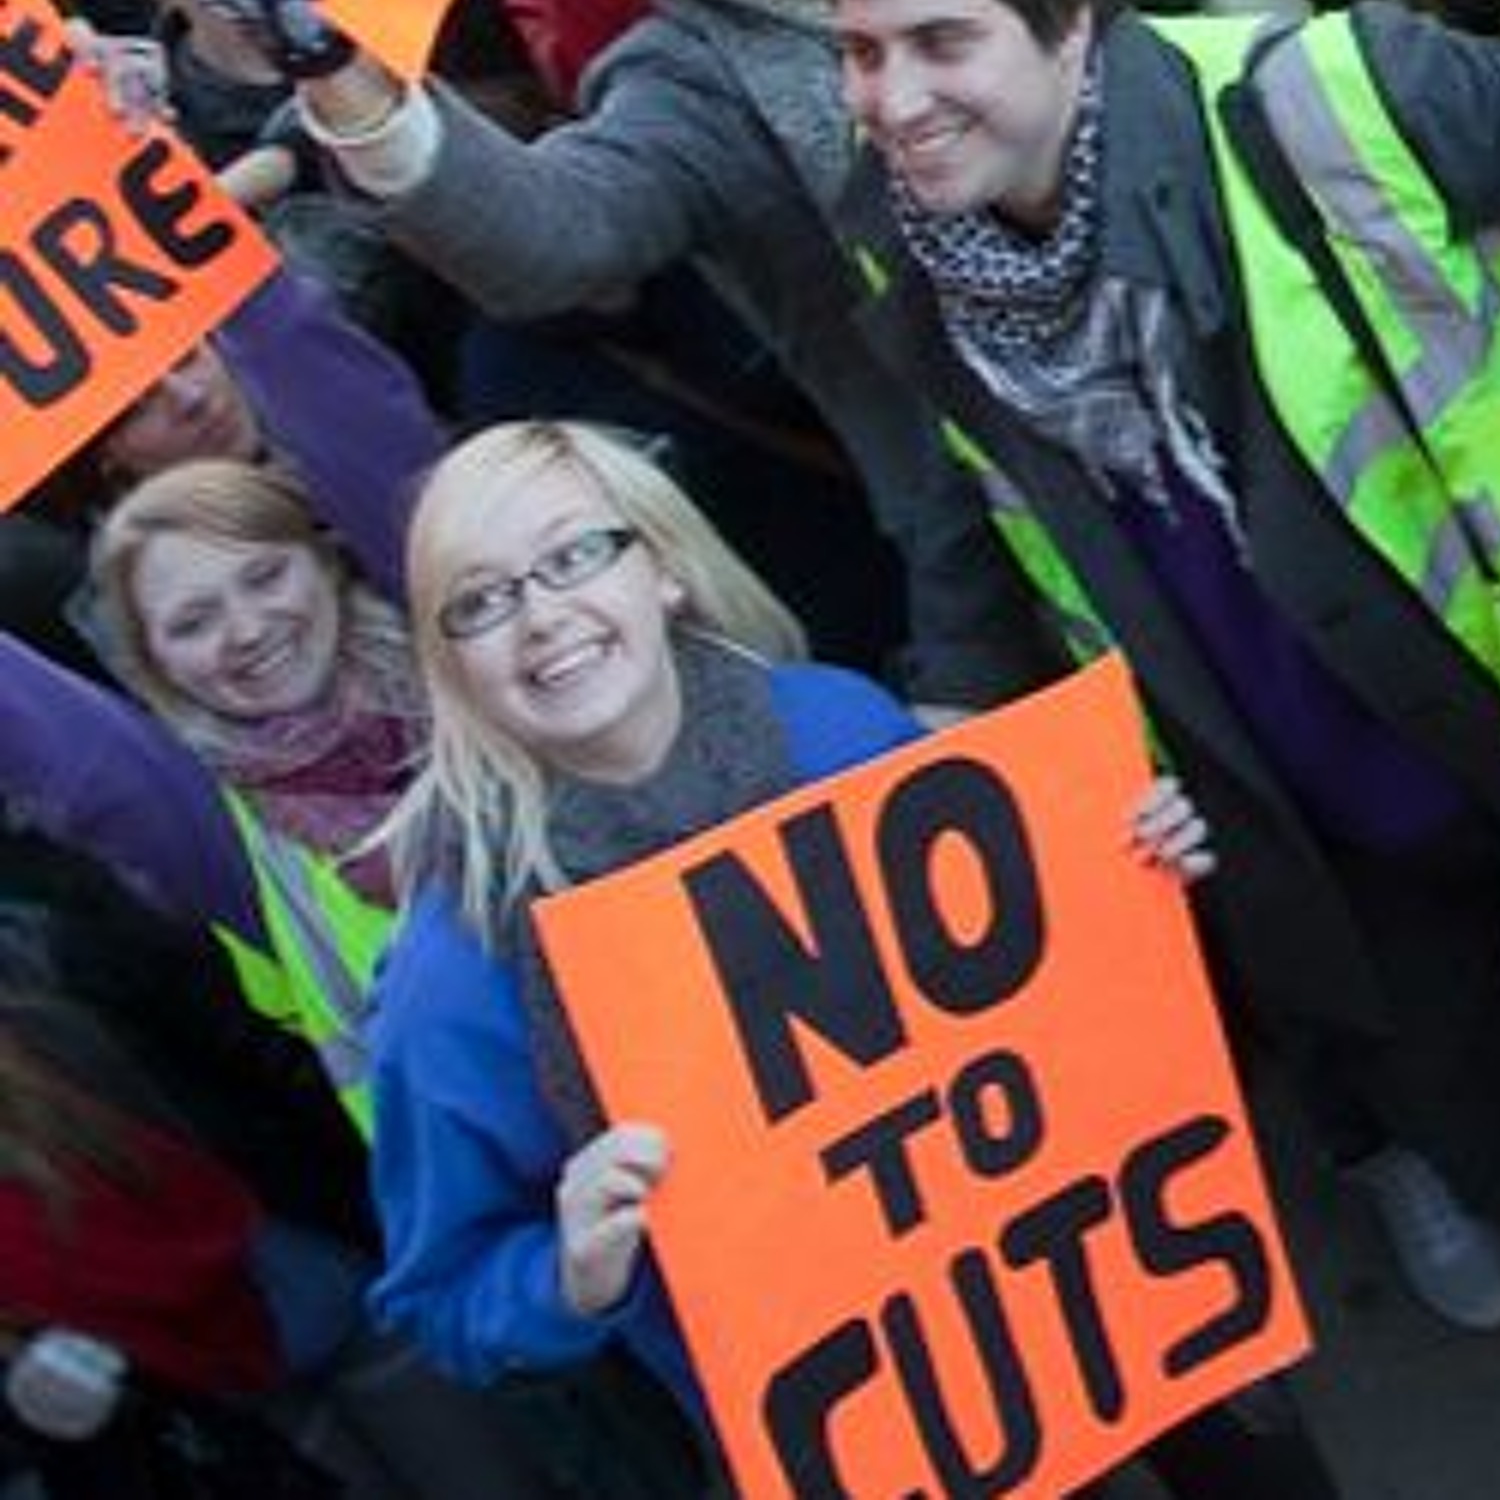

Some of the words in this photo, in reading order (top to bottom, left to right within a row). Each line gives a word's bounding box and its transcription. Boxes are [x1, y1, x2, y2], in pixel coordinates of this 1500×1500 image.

[0, 137, 236, 408] URE
[681, 754, 1048, 1128] NO
[819, 1047, 1045, 1242] TO
[761, 1113, 1273, 1500] CUTS
